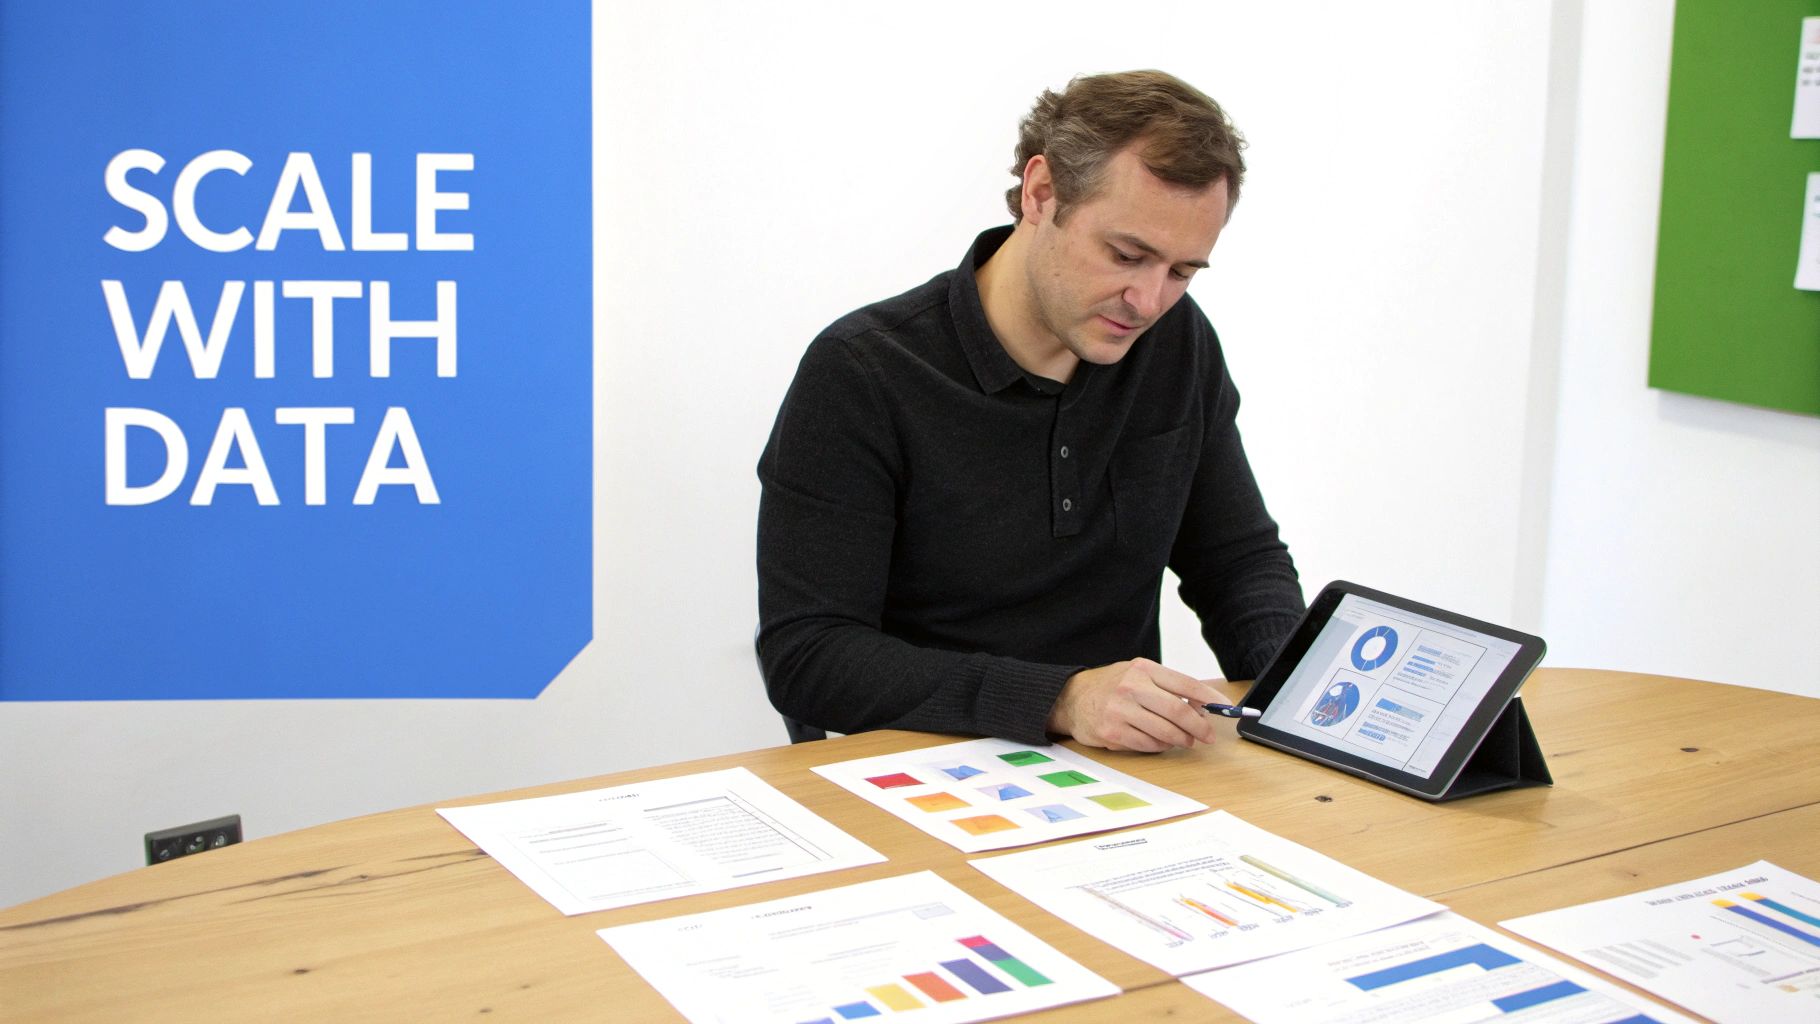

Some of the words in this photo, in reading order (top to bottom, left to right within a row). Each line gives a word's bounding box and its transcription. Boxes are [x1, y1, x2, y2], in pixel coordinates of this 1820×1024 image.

[104, 149, 475, 252] SCALE
[101, 280, 458, 379] WITH
[105, 407, 441, 506] DATA
